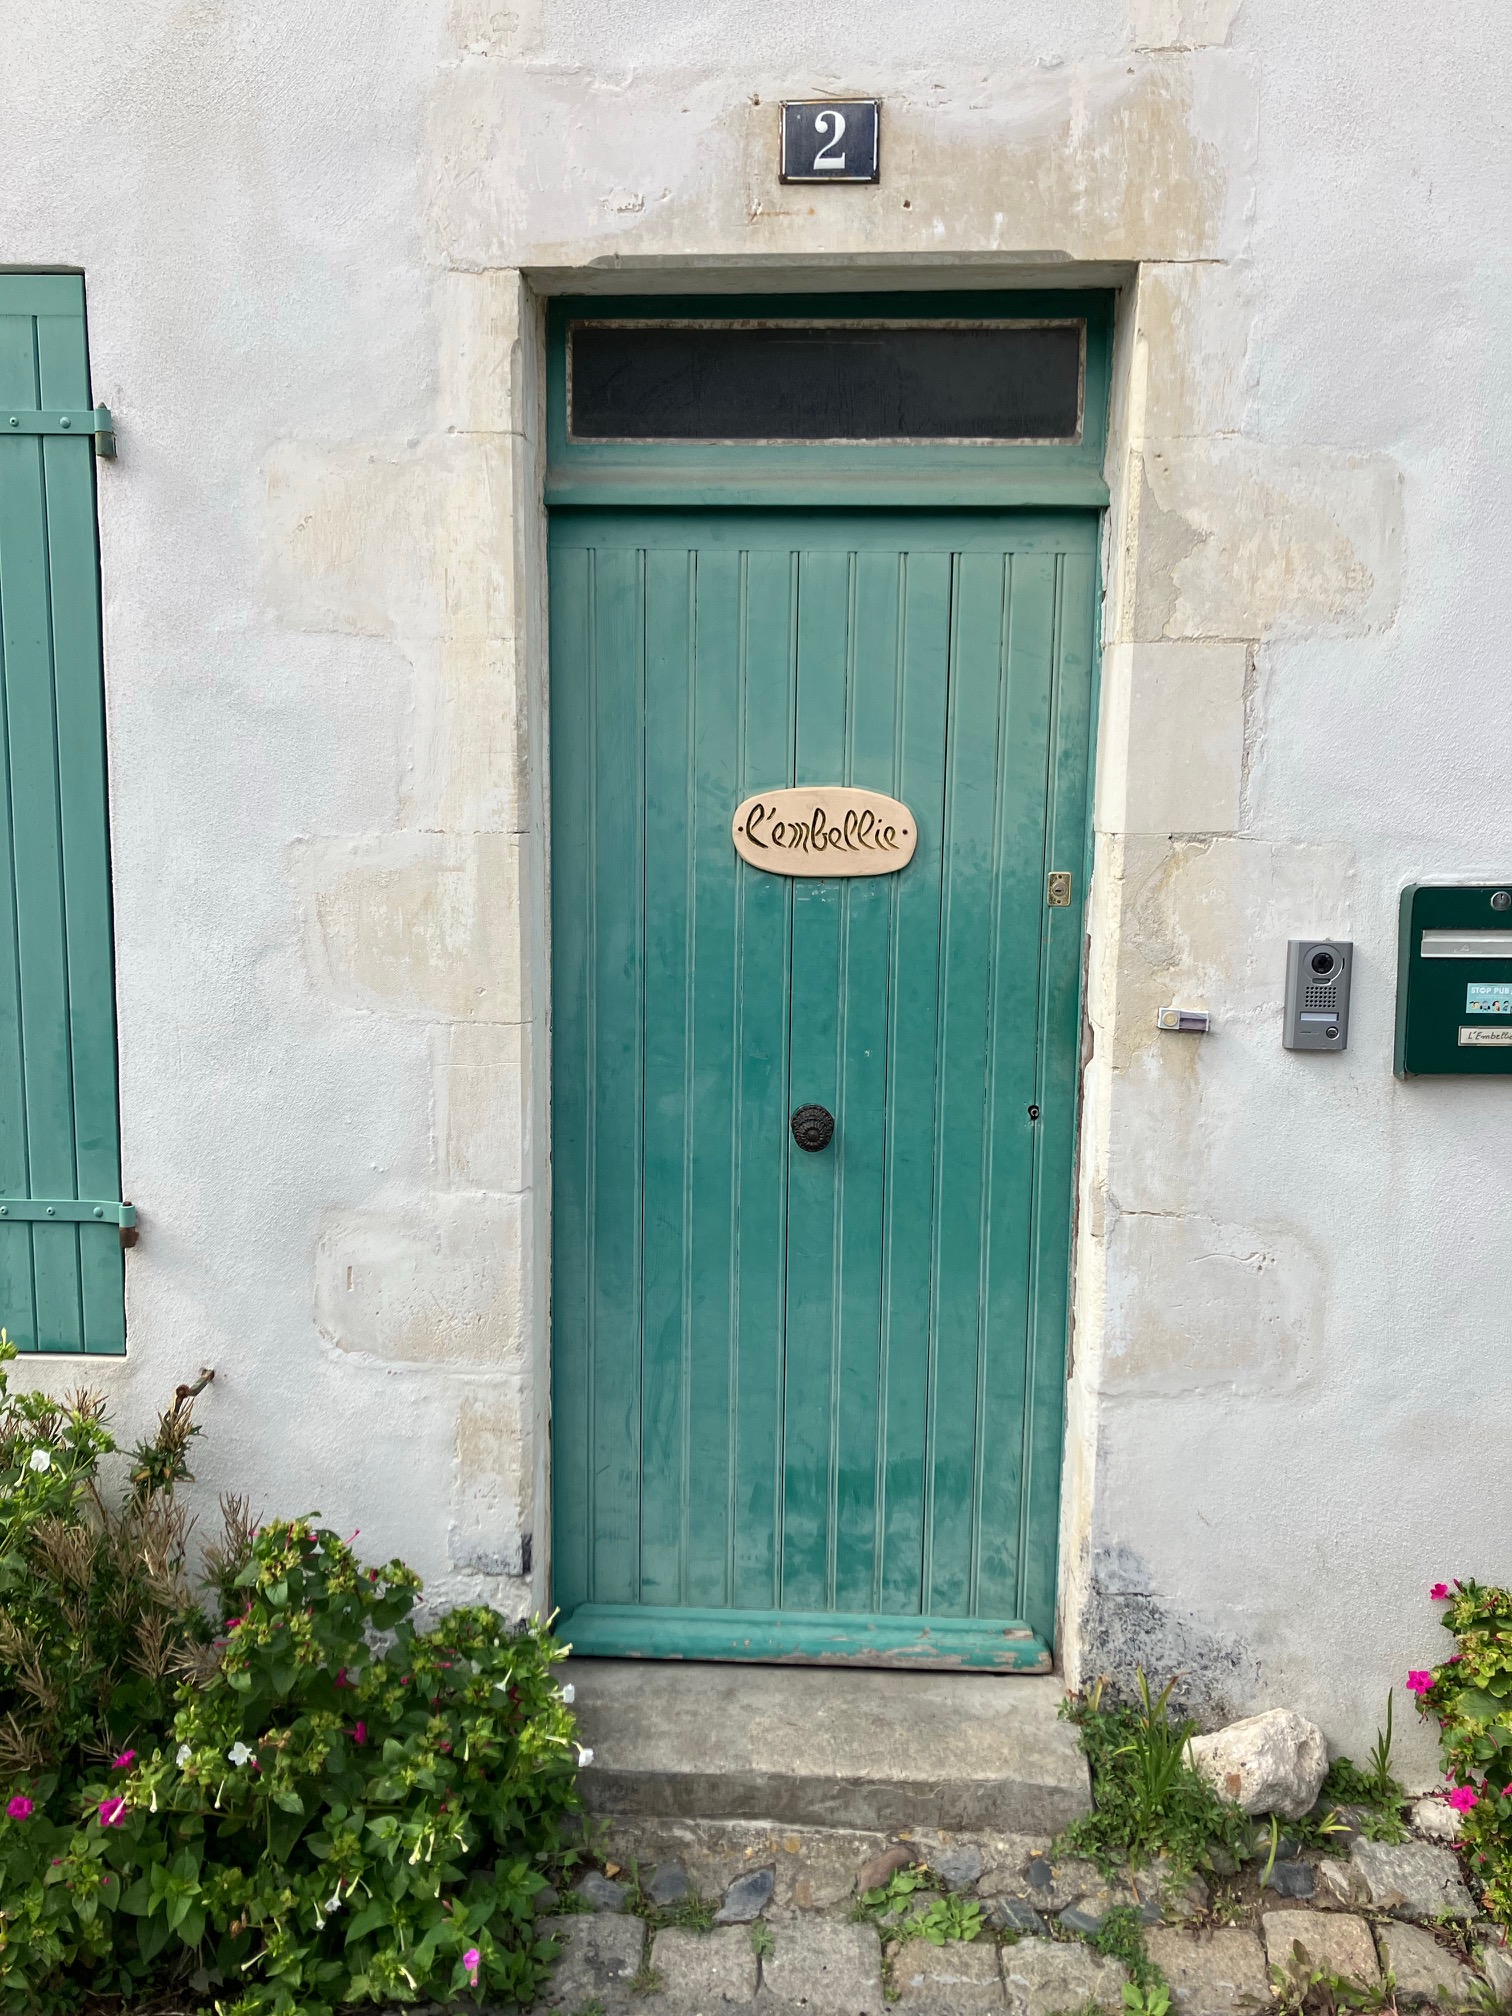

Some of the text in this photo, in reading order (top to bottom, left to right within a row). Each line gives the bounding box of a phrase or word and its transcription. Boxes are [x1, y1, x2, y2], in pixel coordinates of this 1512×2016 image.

[813, 110, 846, 170] 2
[746, 803, 900, 853] l'embellie
[1494, 987, 1510, 995] PUB
